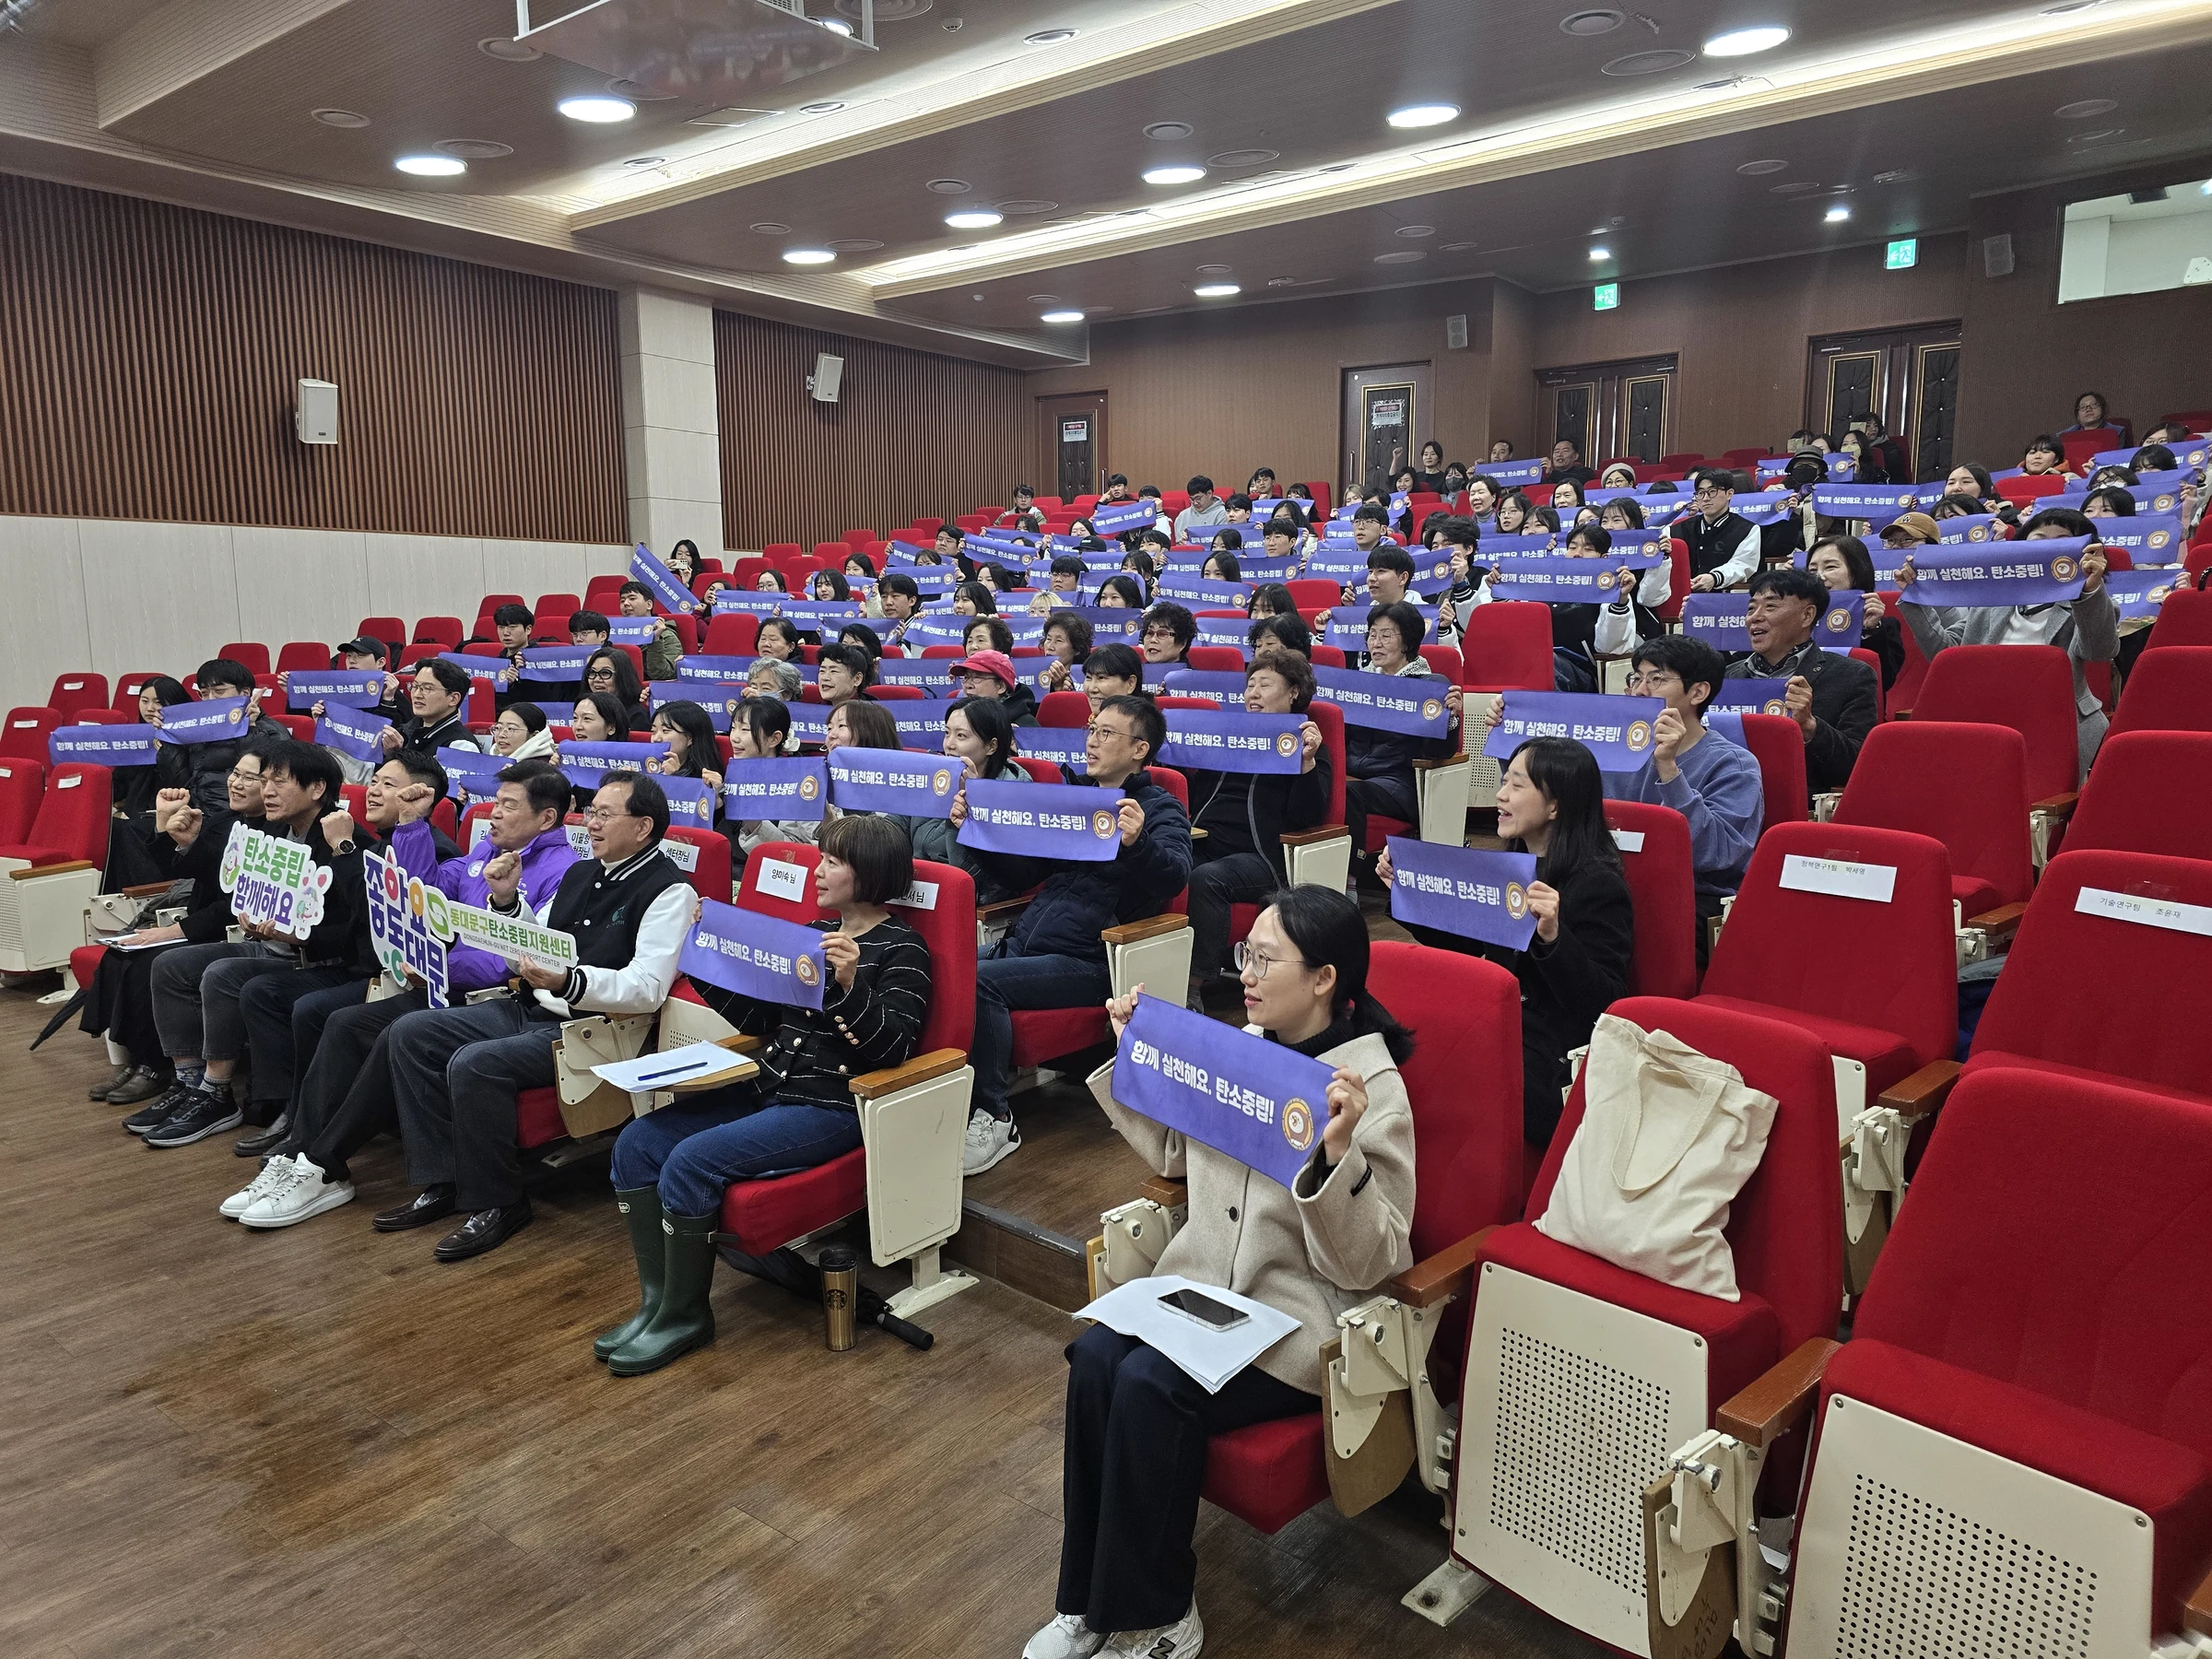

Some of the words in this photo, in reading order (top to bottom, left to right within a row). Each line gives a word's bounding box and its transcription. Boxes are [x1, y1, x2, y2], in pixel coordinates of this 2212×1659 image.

[1833, 496, 1862, 504] 실천해요.
[1500, 573, 1516, 582] 함께
[1519, 573, 1554, 584] 실천해요.
[1556, 575, 1592, 585] 탄소중립!
[1916, 569, 1937, 581] 함께
[1940, 567, 1988, 581] 실천해요.
[1991, 564, 2043, 579] 탄소중립!
[641, 562, 660, 583] 실천해요.
[658, 582, 680, 601] 탄소중립!
[1174, 589, 1200, 599] 실천해요.
[1202, 594, 1230, 604] 탄소중립!
[1095, 623, 1122, 632] 탄소중립!
[1334, 625, 1348, 633] 함께
[1693, 616, 1714, 628] 함께
[1211, 634, 1241, 644] 실천해요.
[680, 667, 692, 677] 함께
[694, 668, 722, 678] 실천해요.
[885, 676, 896, 685] 함께
[898, 676, 924, 685] 실천해요.
[309, 685, 336, 693] 실천해요.
[337, 684, 363, 693] 탄소중립!
[1316, 686, 1333, 699] 함께
[1336, 690, 1373, 705] 실천해요.
[1377, 697, 1417, 712] 탄소중립!
[1504, 720, 1524, 735] 함께
[1526, 722, 1569, 738] 실천해요.
[1573, 725, 1621, 742] 탄소중립!
[56, 742, 73, 750] 함께
[76, 742, 111, 750] 실천해요.
[112, 740, 148, 749] 탄소중립!
[1166, 732, 1182, 744] 함께
[1184, 734, 1224, 747] 실천해요.
[1228, 736, 1270, 750] 탄소중립!
[561, 755, 576, 764] 함께
[577, 755, 608, 769] 실천해요.
[830, 767, 848, 782] 함께
[851, 771, 887, 785] 실천해요.
[888, 773, 927, 788] 탄소중립!
[738, 783, 767, 796] 실천해요.
[770, 782, 798, 796] 탄소중립!
[971, 806, 988, 822] 함께
[992, 809, 1035, 826] 실천해요.
[1039, 813, 1086, 830] 탄소중립!
[242, 836, 306, 888] 탄소중립
[666, 848, 689, 863] 센터장님
[1397, 869, 1415, 887] 함께
[1417, 874, 1454, 897] 실천해요.
[1457, 881, 1500, 905] 탄소중립!
[234, 873, 293, 926] 함께해요
[2100, 898, 2141, 912] 기술연구팀
[451, 908, 571, 960] 동대문구탄소중립지원센터
[464, 933, 500, 948] DONGDAEMUN-GU
[542, 957, 559, 968] CENTER
[695, 931, 718, 951] 함께
[720, 937, 752, 962] 실천해요.
[754, 949, 791, 975] 탄소중립!
[1131, 1040, 1159, 1071] 함께
[1162, 1053, 1211, 1095] 실천해요.
[1216, 1077, 1275, 1124] 탄소중립!
